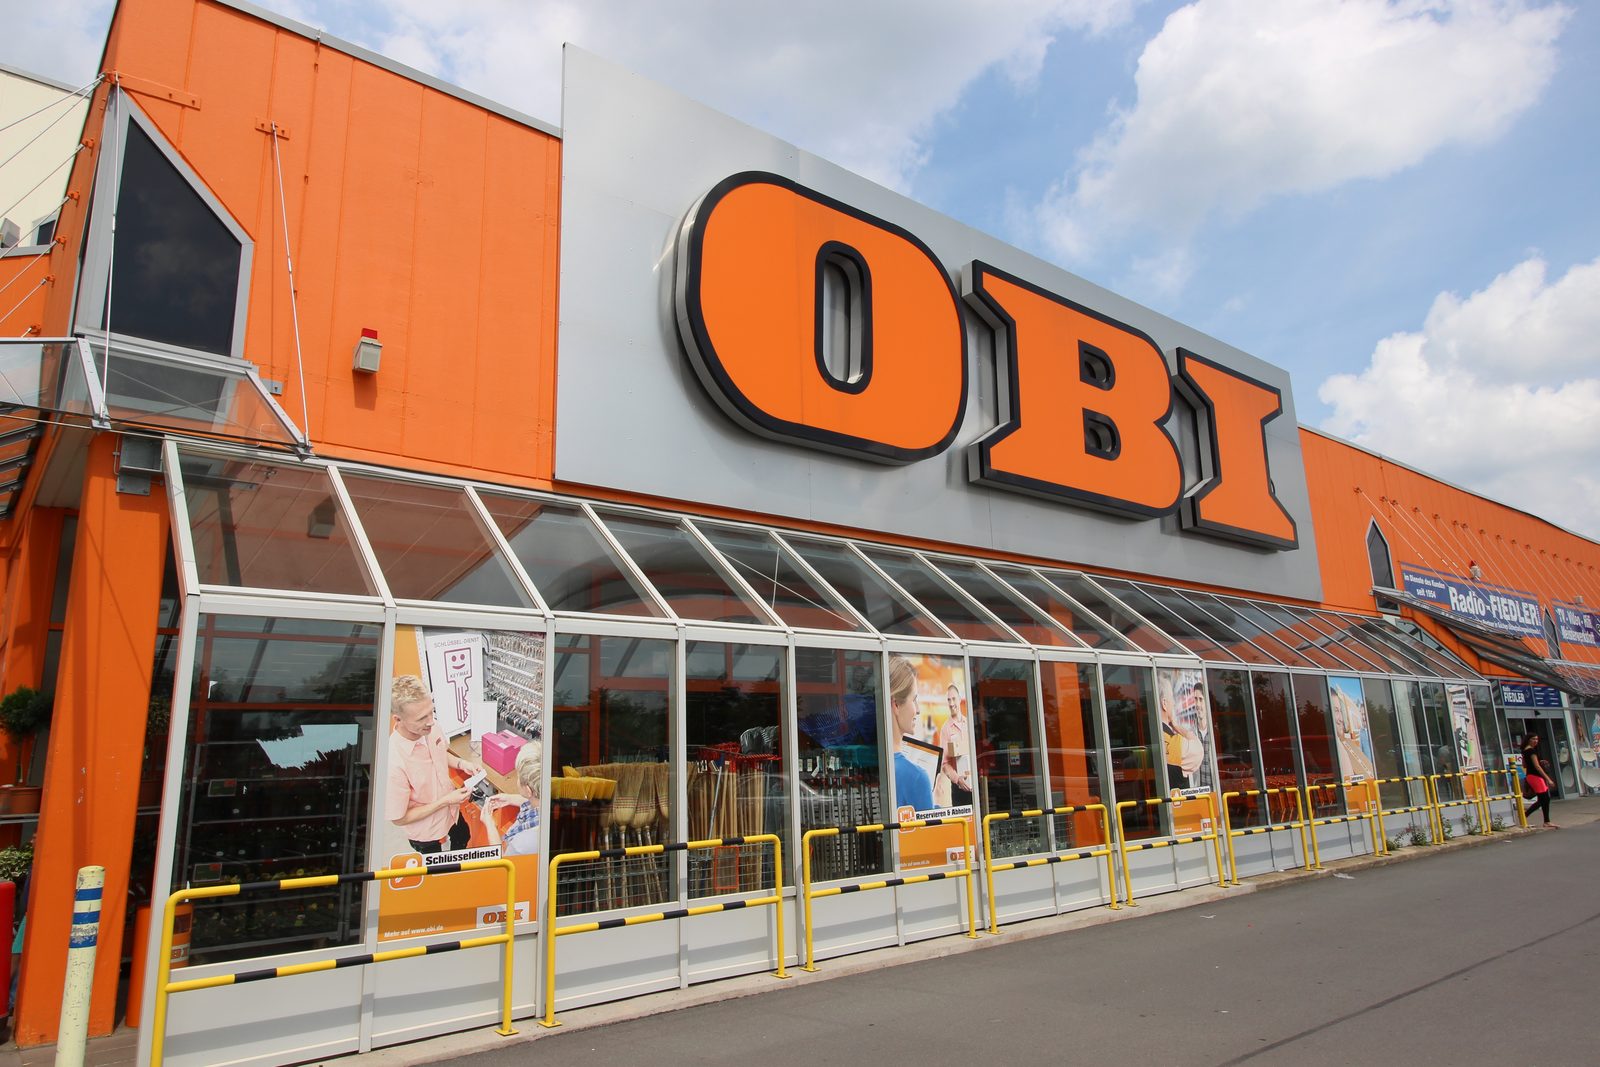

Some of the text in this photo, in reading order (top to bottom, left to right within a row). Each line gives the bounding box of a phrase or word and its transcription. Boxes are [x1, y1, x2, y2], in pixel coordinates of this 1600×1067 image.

[678, 170, 1299, 552] OBI
[1503, 692, 1526, 703] FIEDLER
[916, 811, 947, 820] Reservieren
[951, 807, 971, 816] Abholen
[425, 848, 500, 865] Schlüsseldienst
[384, 925, 444, 938] Mehr auf www.obi.de
